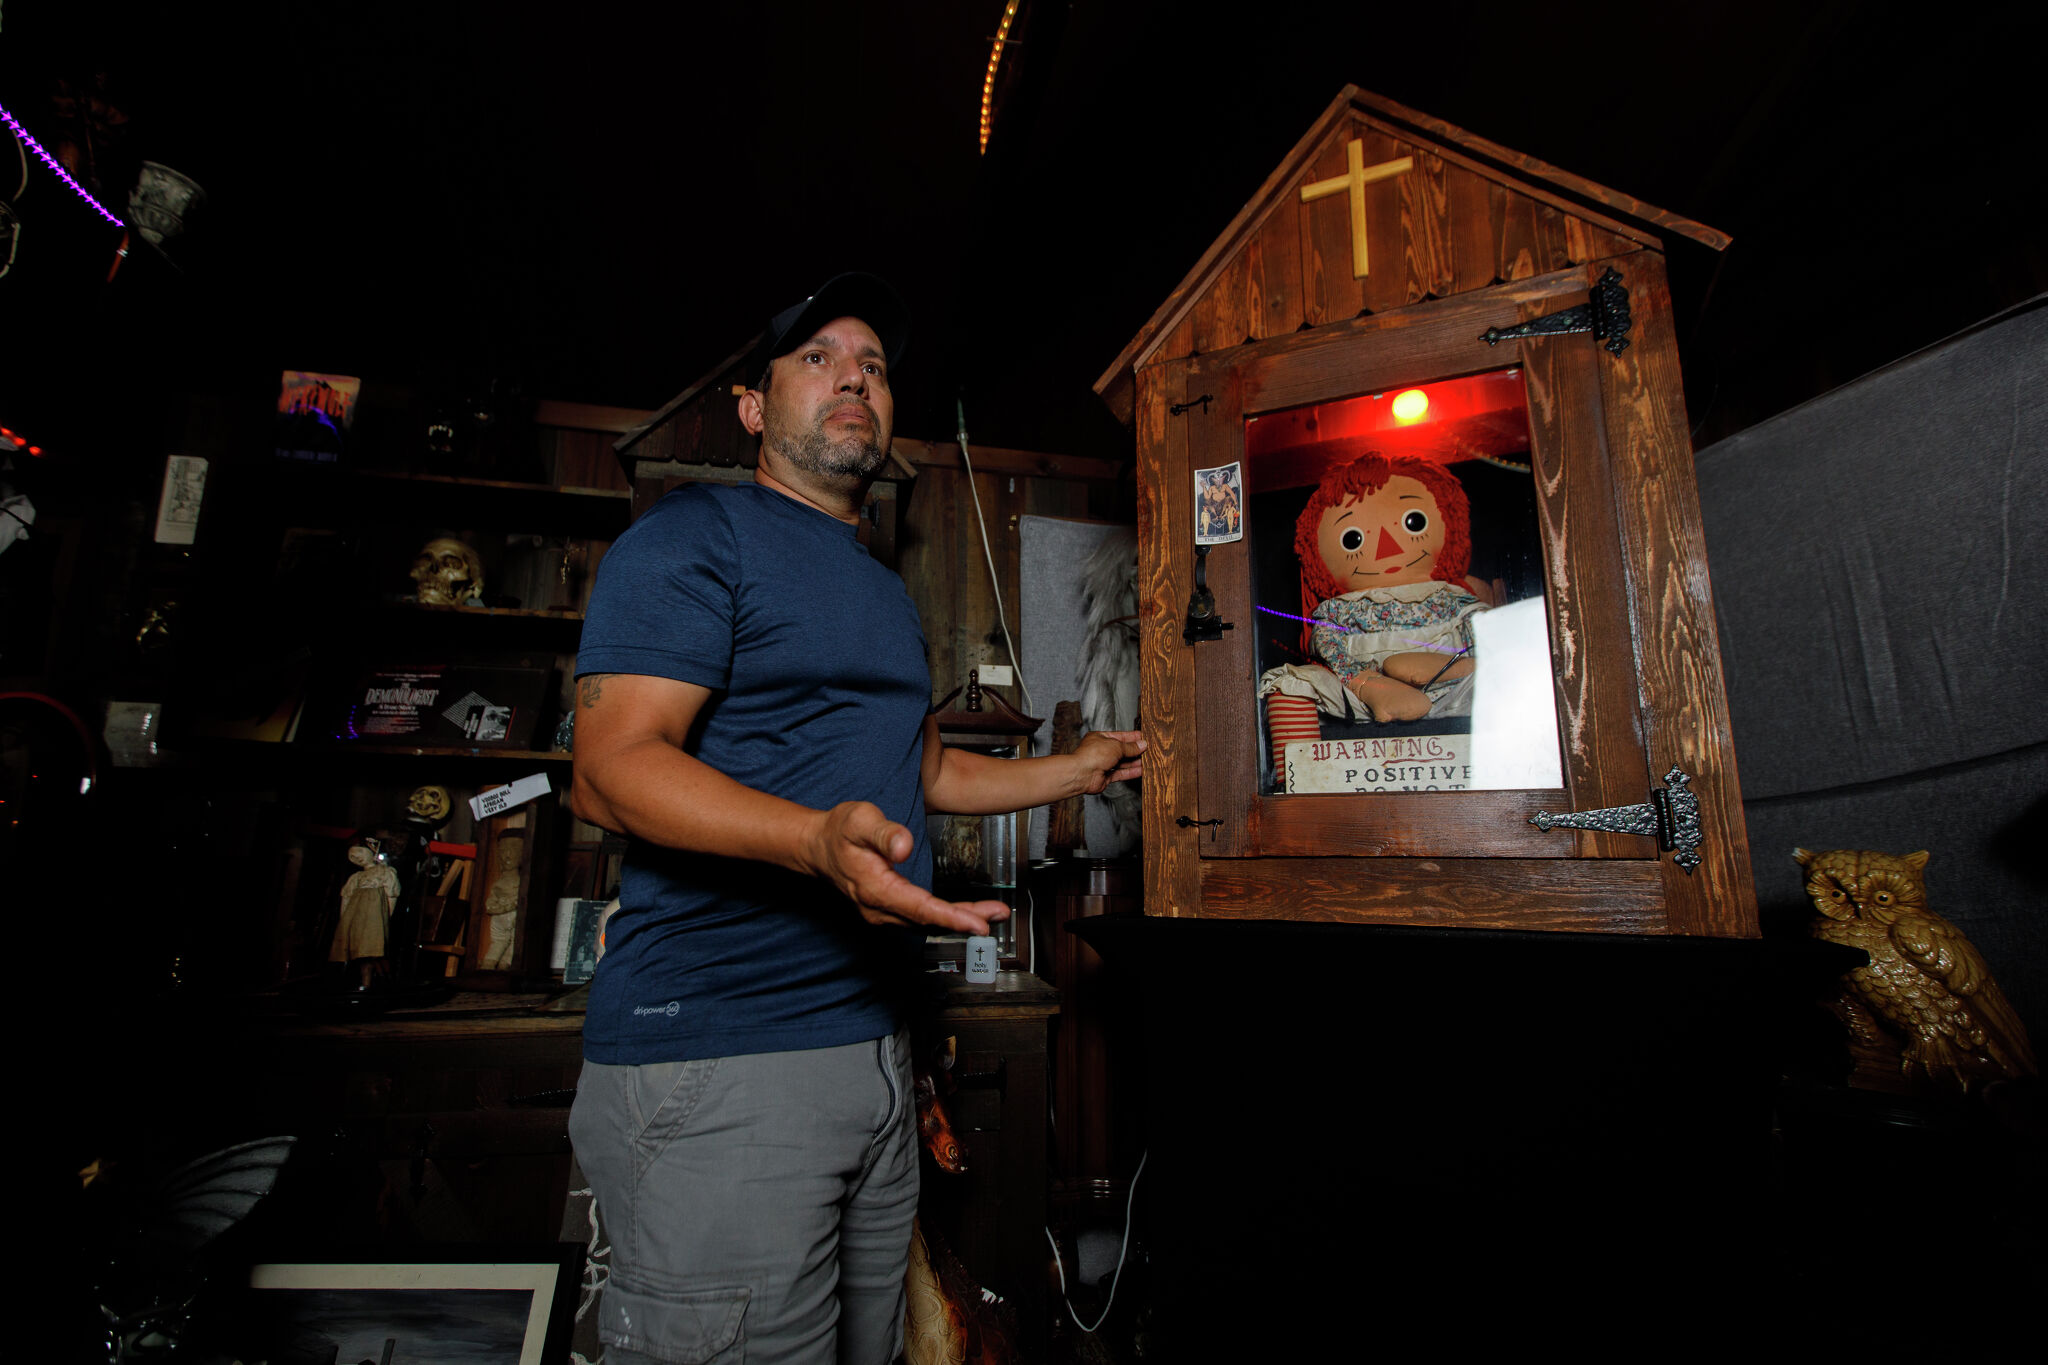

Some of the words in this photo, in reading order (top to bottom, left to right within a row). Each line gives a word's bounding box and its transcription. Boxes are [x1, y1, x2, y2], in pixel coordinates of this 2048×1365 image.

[364, 687, 440, 706] DEMONOLOGIST
[1312, 737, 1443, 761] WARNING
[482, 793, 499, 803] VOODOO
[499, 788, 511, 797] DOLL
[483, 798, 504, 808] AFRICAN
[485, 806, 497, 814] VERY
